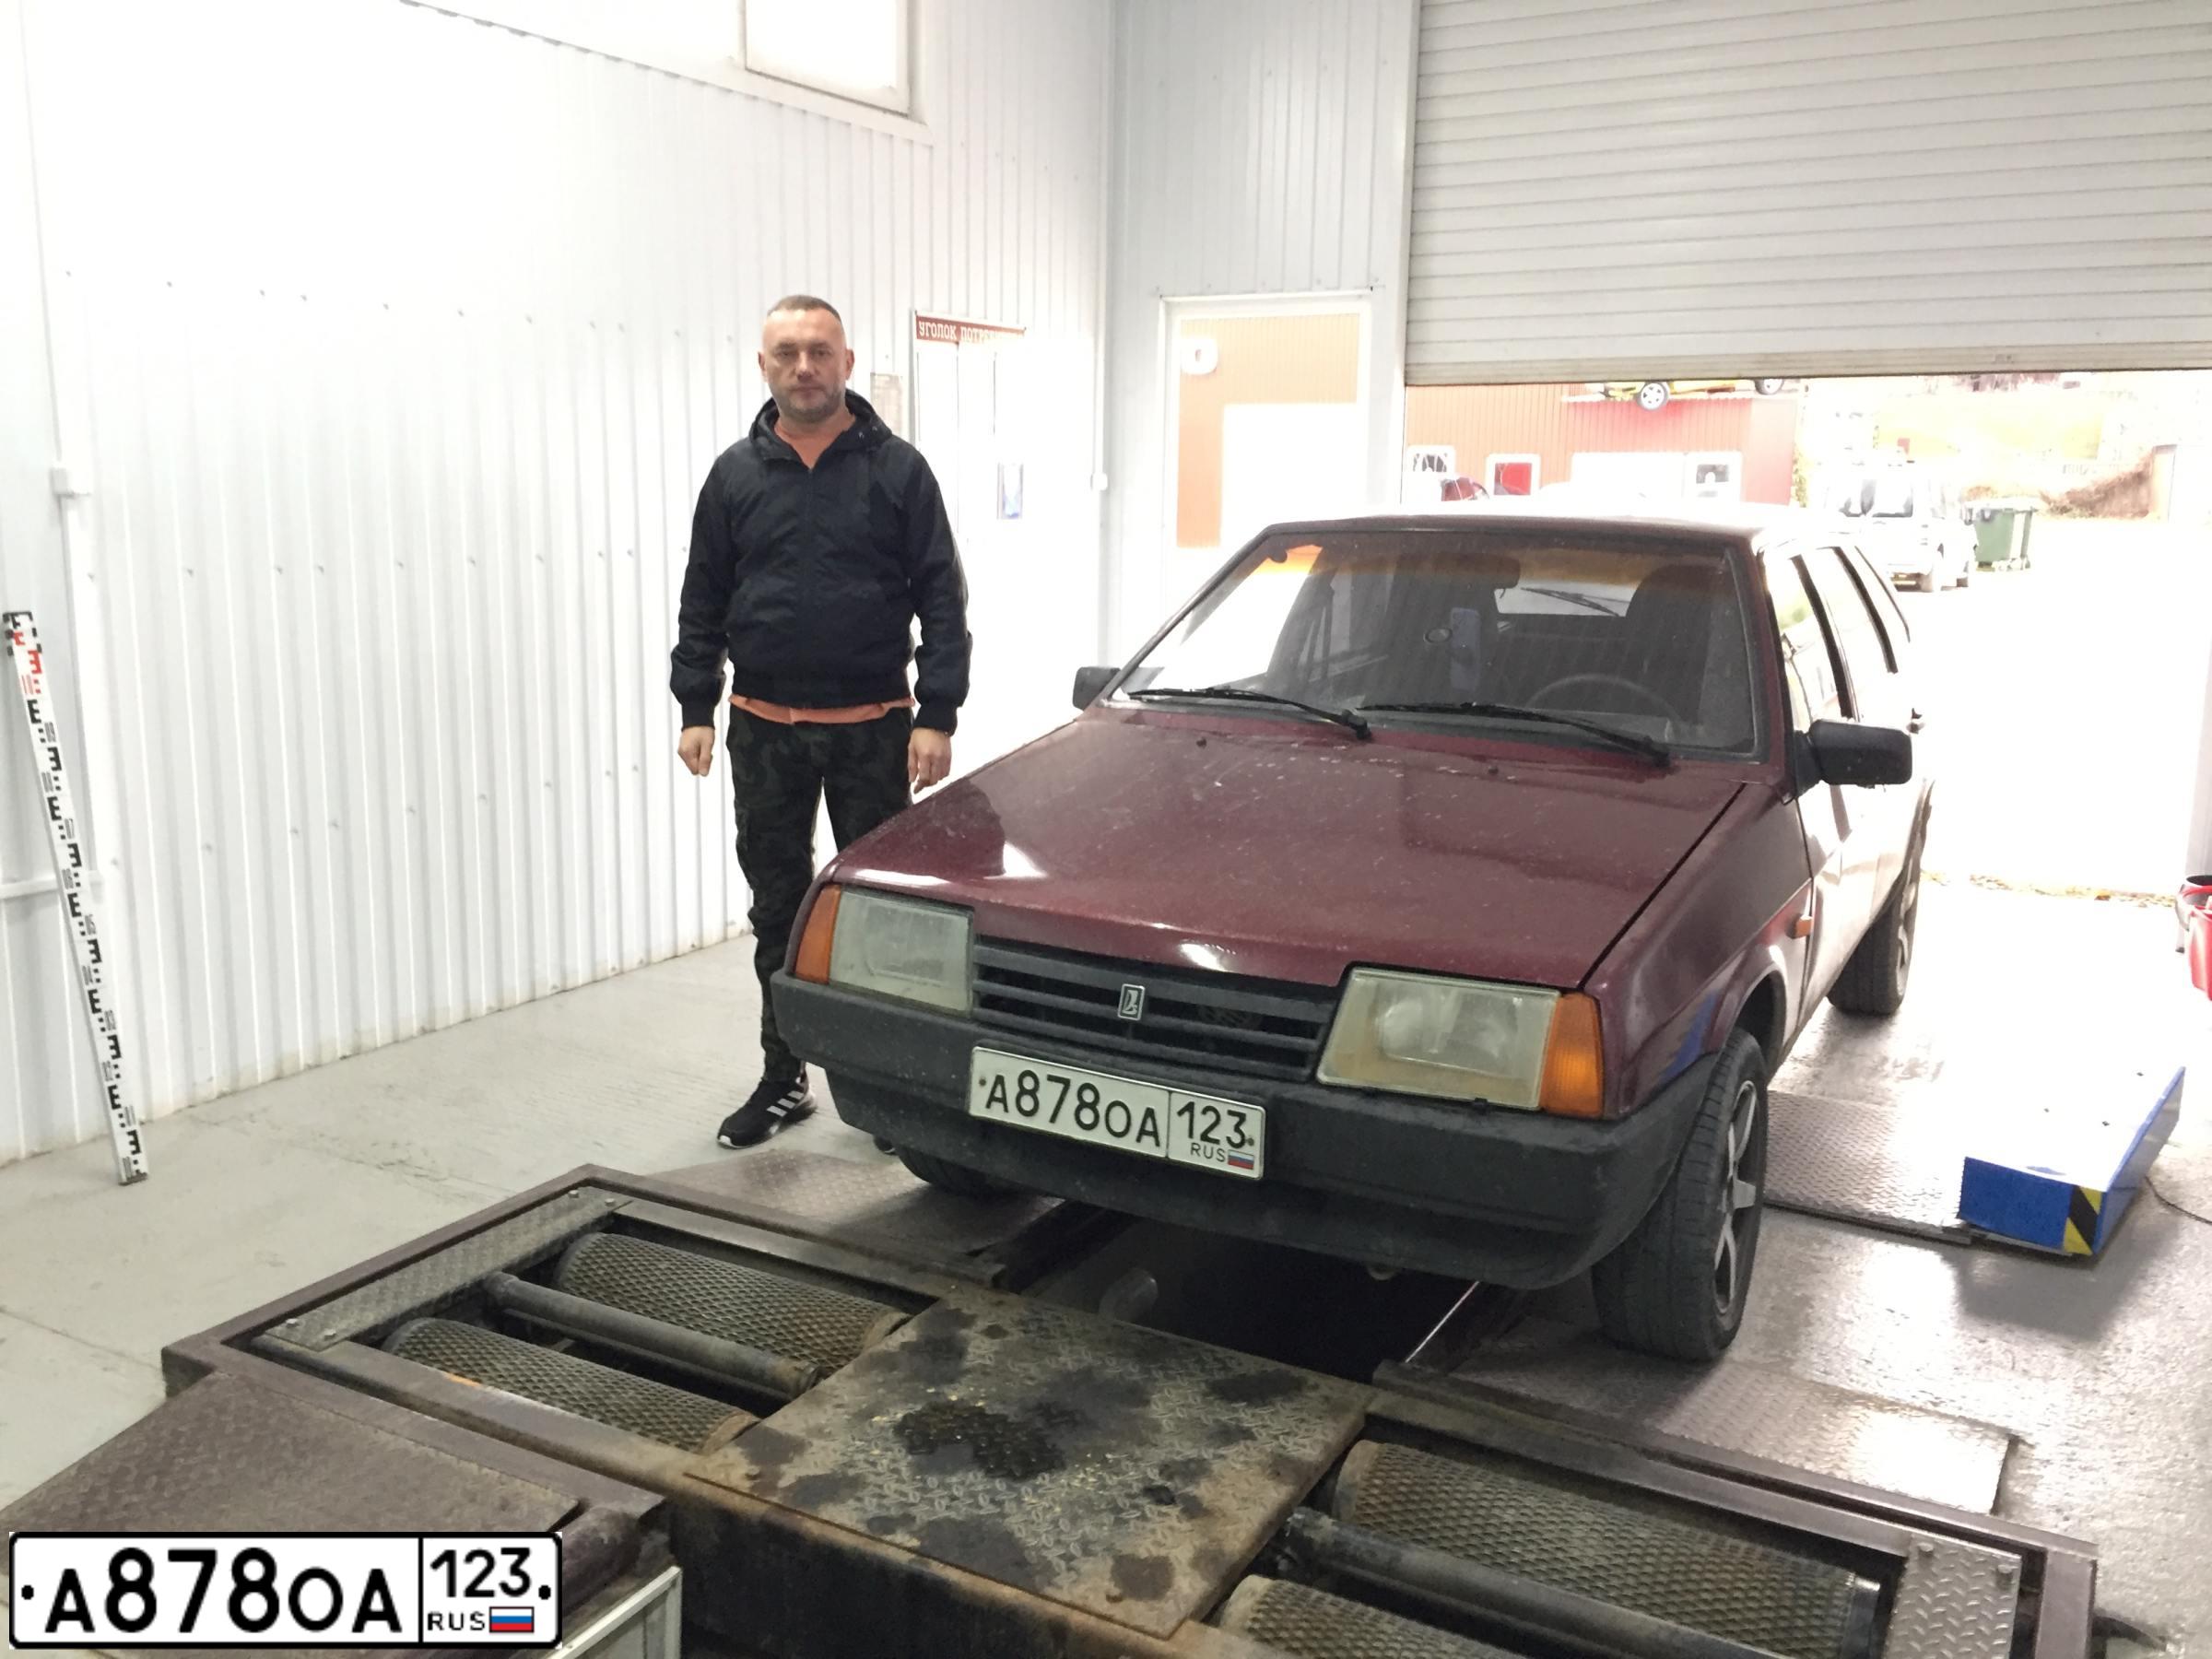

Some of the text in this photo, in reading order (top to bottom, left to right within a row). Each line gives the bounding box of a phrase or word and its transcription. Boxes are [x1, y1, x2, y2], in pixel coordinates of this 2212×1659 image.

[919, 321, 958, 340] УГОЛОК
[1176, 1100, 1247, 1148] 123
[1190, 1142, 1226, 1162] RUS
